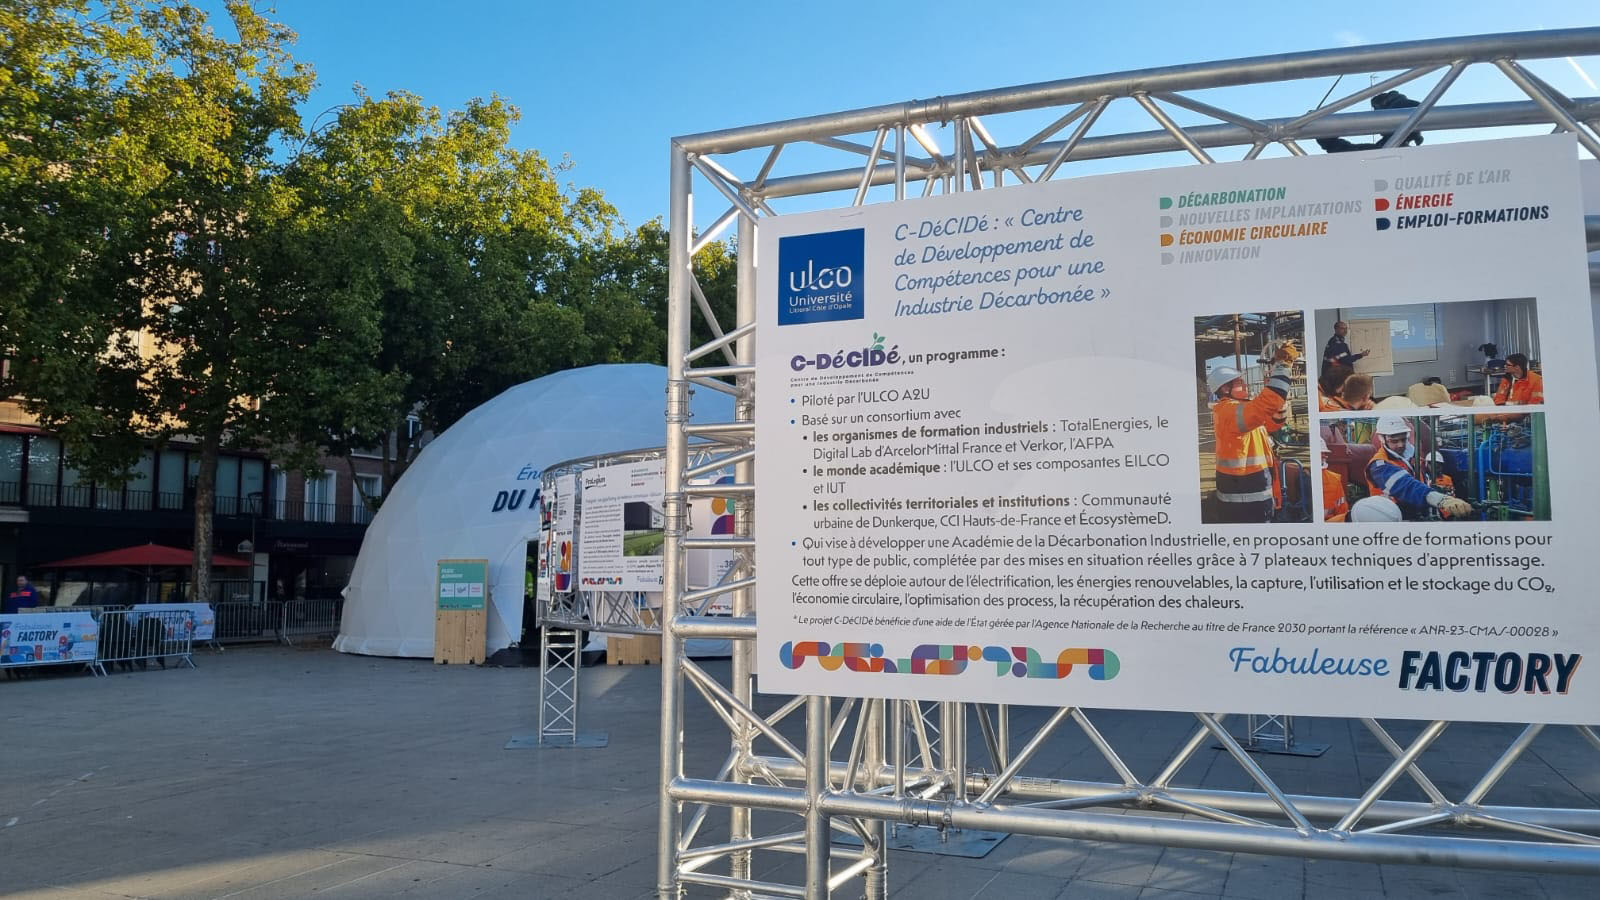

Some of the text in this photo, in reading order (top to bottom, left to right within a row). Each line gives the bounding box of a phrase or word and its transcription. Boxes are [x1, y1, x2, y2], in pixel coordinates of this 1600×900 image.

[1394, 169, 1511, 192] QUALITÉ DE L'AIR
[1178, 186, 1286, 208] DÉCARBONATION
[1395, 193, 1453, 210] ÉNERGIE
[894, 206, 1083, 240] C-DéCIDé Centre
[1178, 200, 1362, 227] NOUVELLES IMPLANTATIONS
[1396, 205, 1548, 229] EMPLOI-FORMATIONS
[1179, 221, 1328, 245] ÉCONOMIE CIRCULAIRE
[894, 229, 1094, 266] de Développement de
[1179, 245, 1260, 264] INNOVATION
[790, 259, 852, 292] ulco
[894, 261, 1104, 292] Compétences pour une
[789, 291, 853, 307] Université
[894, 284, 1095, 316] Industrie Décarbonée
[908, 354, 922, 363] un
[926, 348, 998, 364] programme
[802, 388, 929, 407] Piloté par l'ULCO A2U
[802, 409, 961, 425] Basé sur un consortium avec
[813, 416, 1168, 444] les organismes de formation industriels TotalEnergies, le
[813, 436, 1114, 462] Digital Lab d'ArcelorMittal France et Verkor, l'AFPA
[813, 453, 1169, 476] le monde académique l'ULCO et ses composantes EILCO
[813, 481, 845, 494] et IUT
[492, 489, 526, 512] DU
[813, 492, 1171, 511] les collectivités territoriales et institutions Communauté
[813, 508, 1171, 530] urbaine de Dunkerque, CCI Hauts-de-France et ÉcosystèmeD.
[802, 532, 1552, 551] Qui vise à développer une Académie de la Décarbonation Industrielle, en proposant une offre de formations pour
[802, 553, 1544, 570] tout type de public, complétée par des mises en situation réelles grâce à 7 plateaux techniques d'apprentissage.
[791, 574, 819, 586] Cette
[821, 574, 848, 586] offre
[850, 578, 862, 586] se
[864, 574, 906, 589] déploie
[909, 576, 946, 587] autour
[948, 574, 963, 587] de
[966, 574, 1053, 589] l'électrification,
[1057, 574, 1073, 587] les
[1076, 574, 1131, 591] énergies
[1134, 575, 1232, 591] renouvelables,
[1236, 575, 1247, 588] la
[1250, 577, 1306, 592] capture,
[1310, 575, 1383, 589] l'utilisation
[1387, 578, 1402, 590] et
[1405, 576, 1418, 590] le
[1422, 576, 1490, 594] stockage
[1494, 576, 1513, 590] du
[792, 591, 1243, 610] l'économie circulaire, l'optimisation des process, la récupération des chaleurs.
[17, 630, 59, 642] FACTORY
[1229, 647, 1582, 694] Fabuleuse FACTORY
